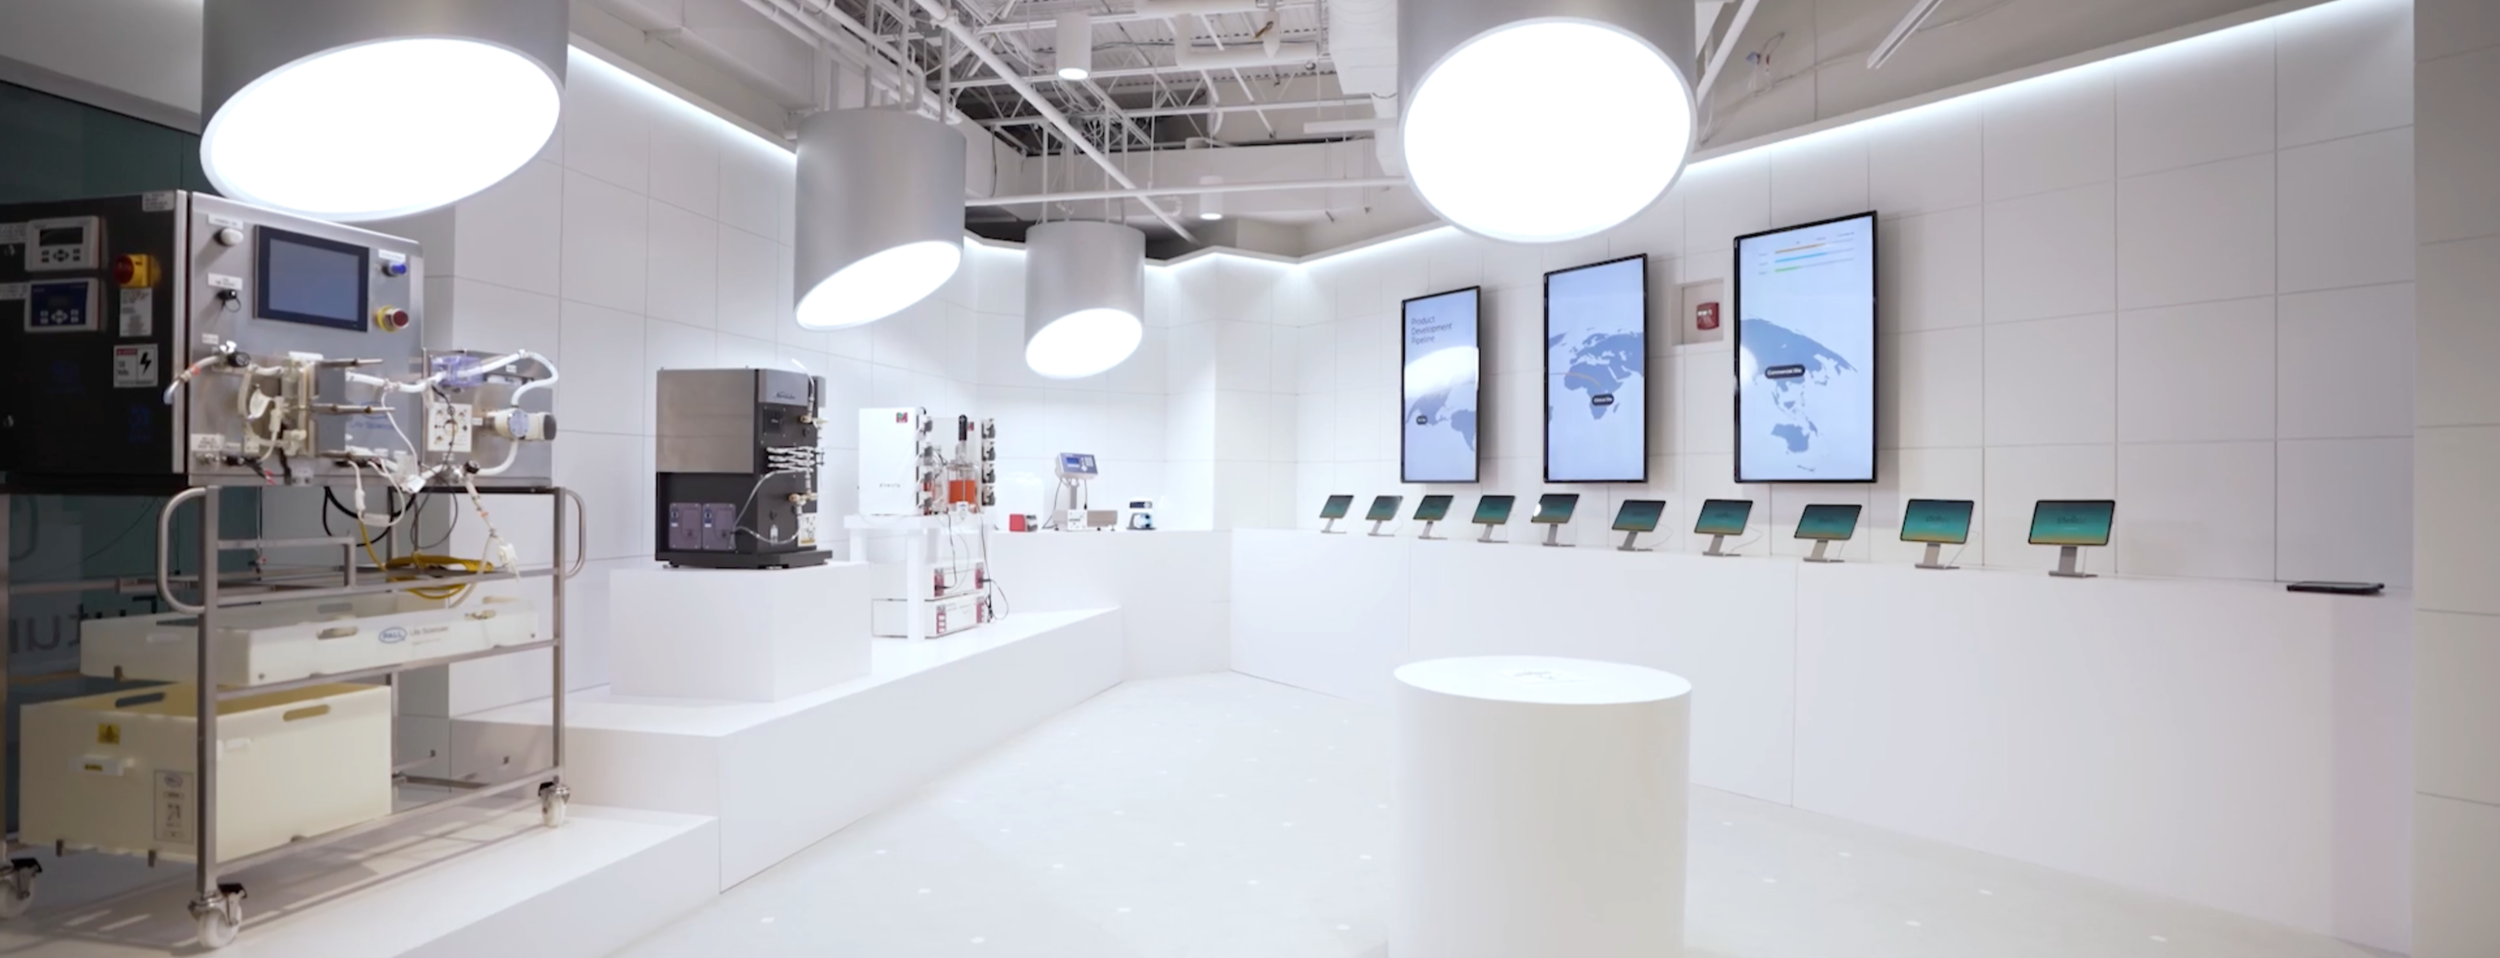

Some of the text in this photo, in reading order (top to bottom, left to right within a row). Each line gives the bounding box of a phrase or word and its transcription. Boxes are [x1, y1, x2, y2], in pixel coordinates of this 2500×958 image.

[1411, 316, 1435, 325] Product
[1411, 323, 1452, 335] Development
[1411, 336, 1435, 345] Pipeline
